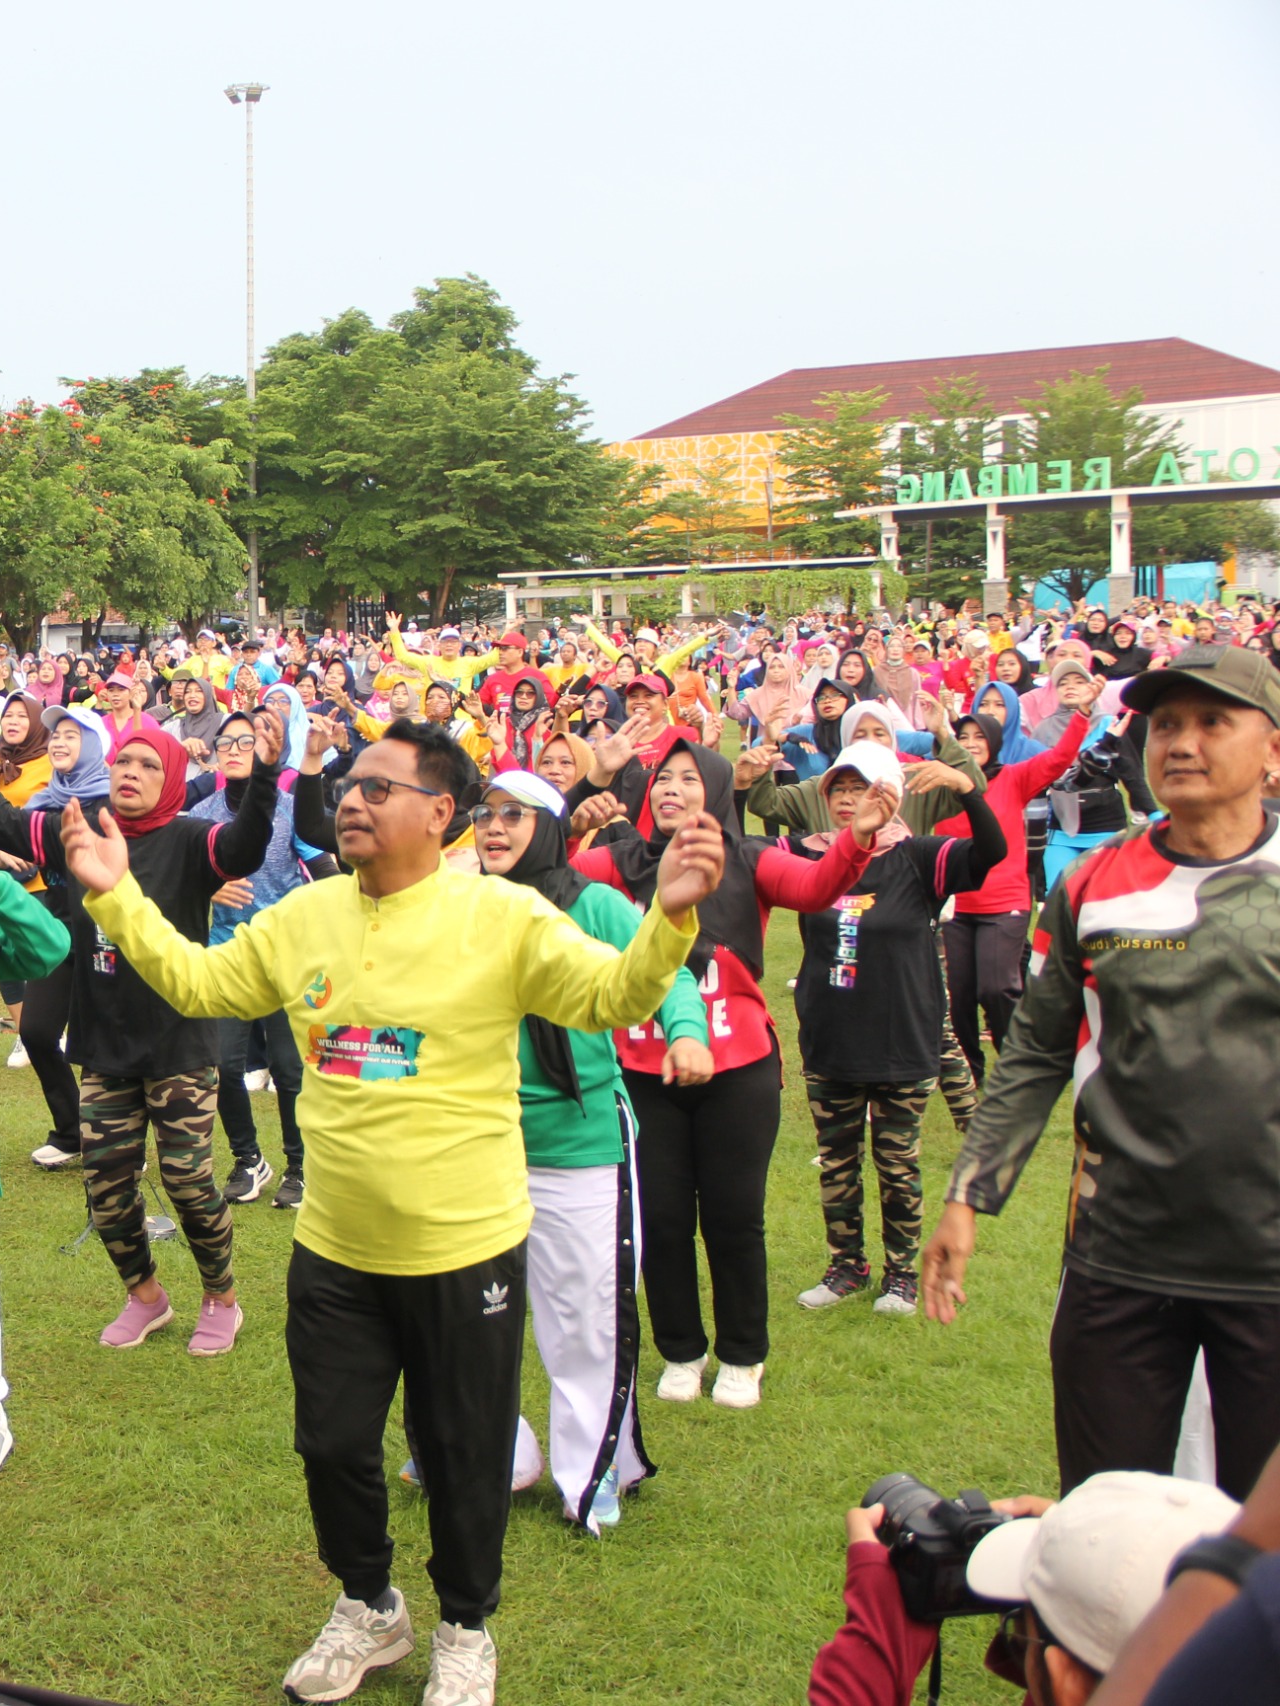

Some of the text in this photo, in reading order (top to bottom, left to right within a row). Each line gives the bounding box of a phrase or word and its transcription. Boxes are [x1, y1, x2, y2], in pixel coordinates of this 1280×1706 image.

[1113, 936, 1187, 951] Susanto
[317, 1038, 404, 1055] WELLNESS FOR ALL
[483, 1302, 508, 1315] adidas
